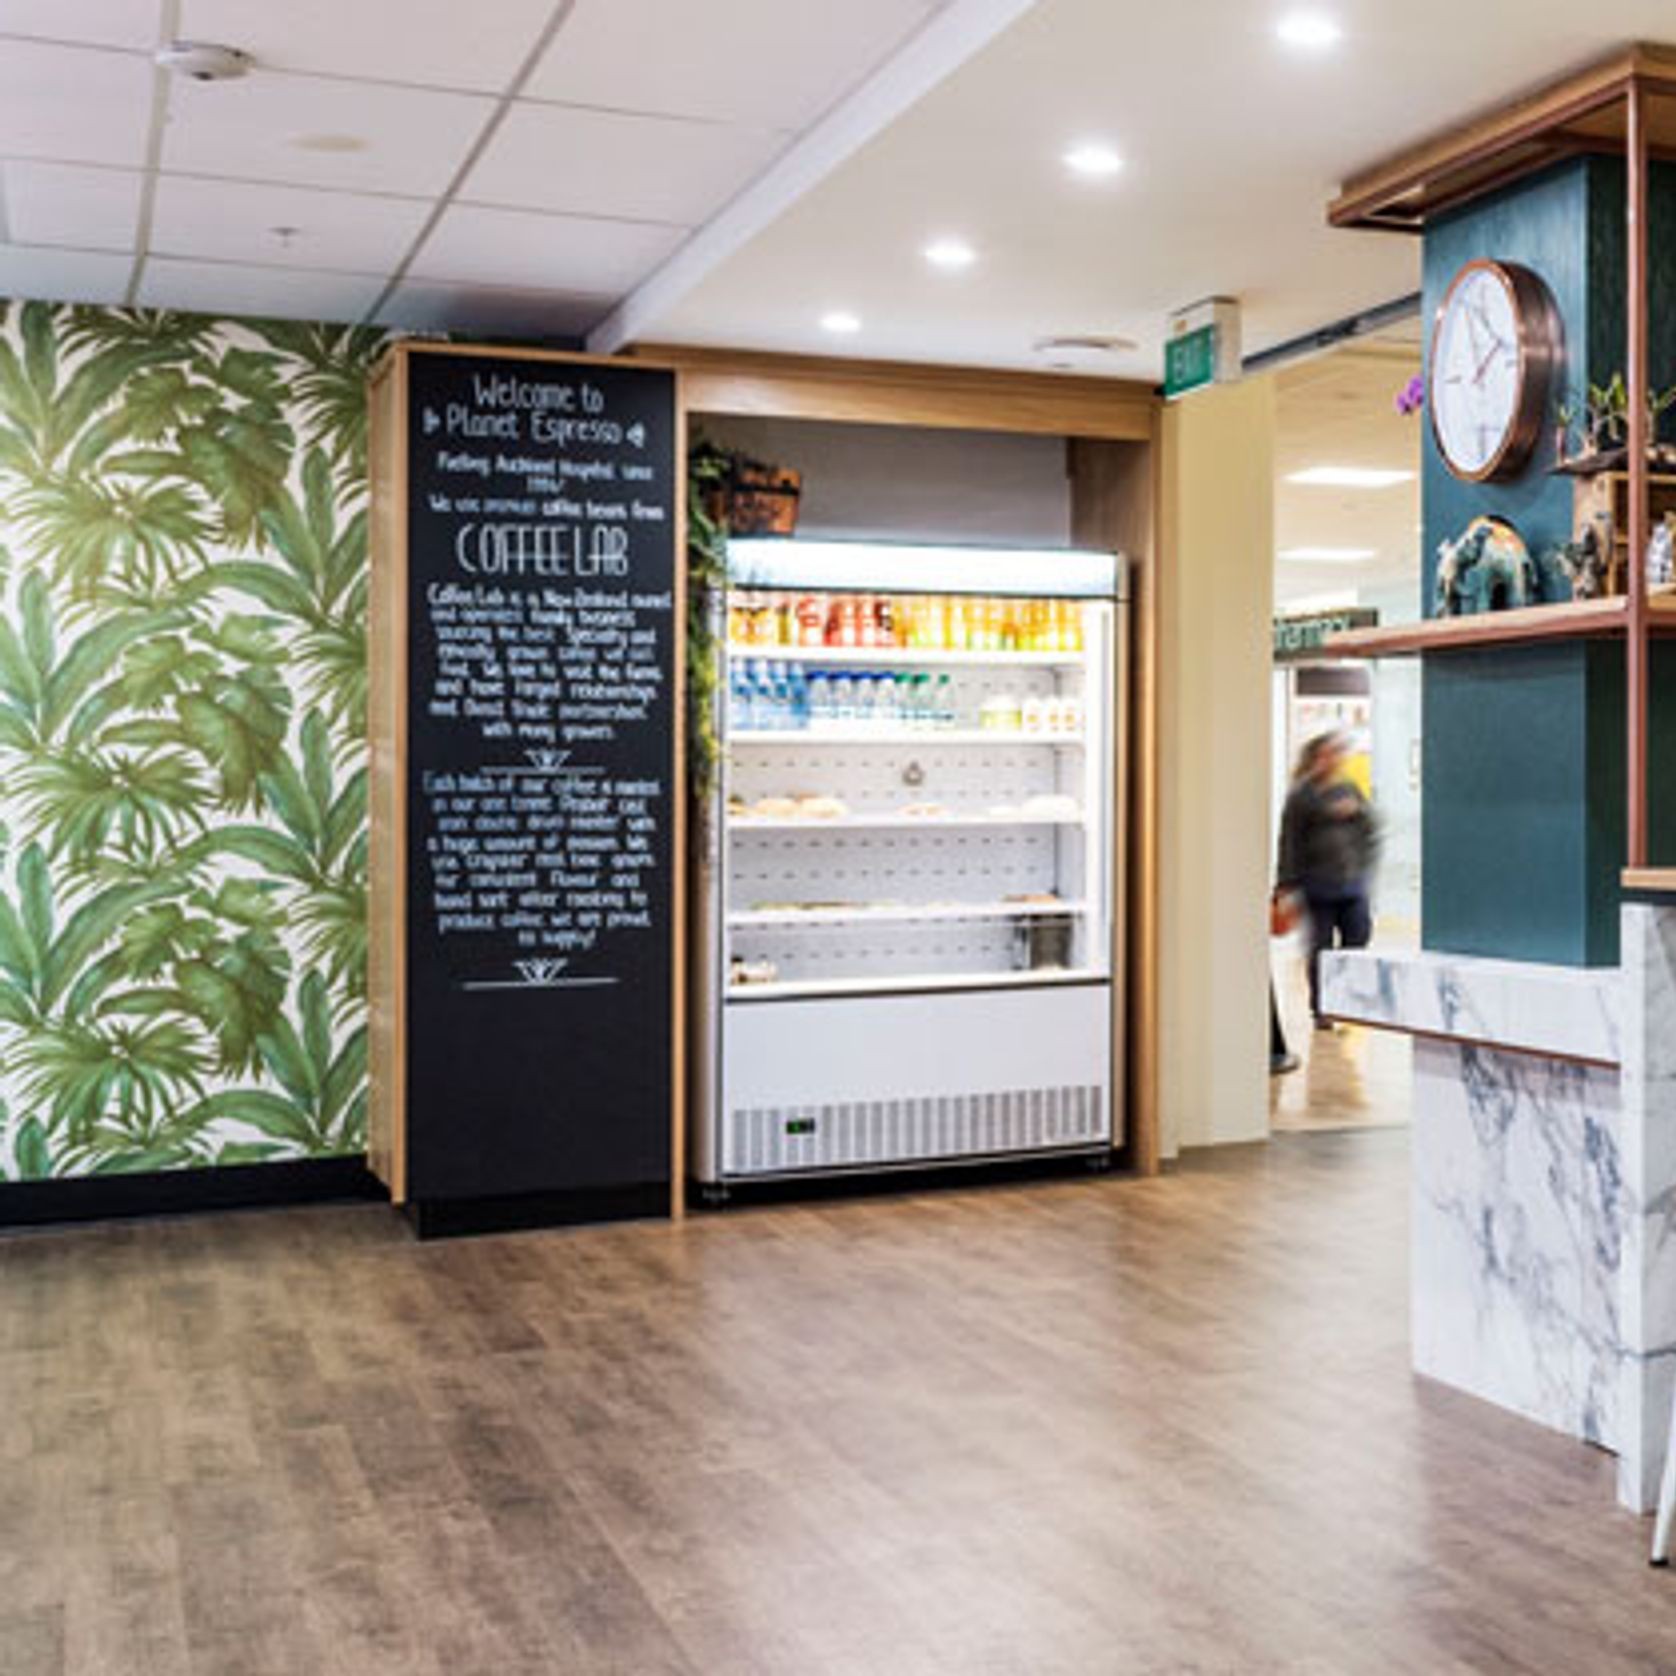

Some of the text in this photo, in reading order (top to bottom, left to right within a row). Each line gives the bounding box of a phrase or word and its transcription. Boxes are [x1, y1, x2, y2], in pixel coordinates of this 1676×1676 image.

[474, 373, 604, 413] Welcome to
[447, 403, 623, 447] Planet Espresso
[429, 494, 450, 511] We
[542, 499, 583, 516] coffee
[587, 501, 627, 519] beans
[631, 501, 664, 519] from
[457, 523, 628, 576] COFFEE LAB
[427, 583, 473, 604] Coffee
[475, 585, 504, 604] Lab
[544, 589, 572, 606] New
[574, 587, 628, 608] Zealand
[483, 723, 512, 737] with
[452, 799, 476, 811] our
[610, 873, 640, 888] and
